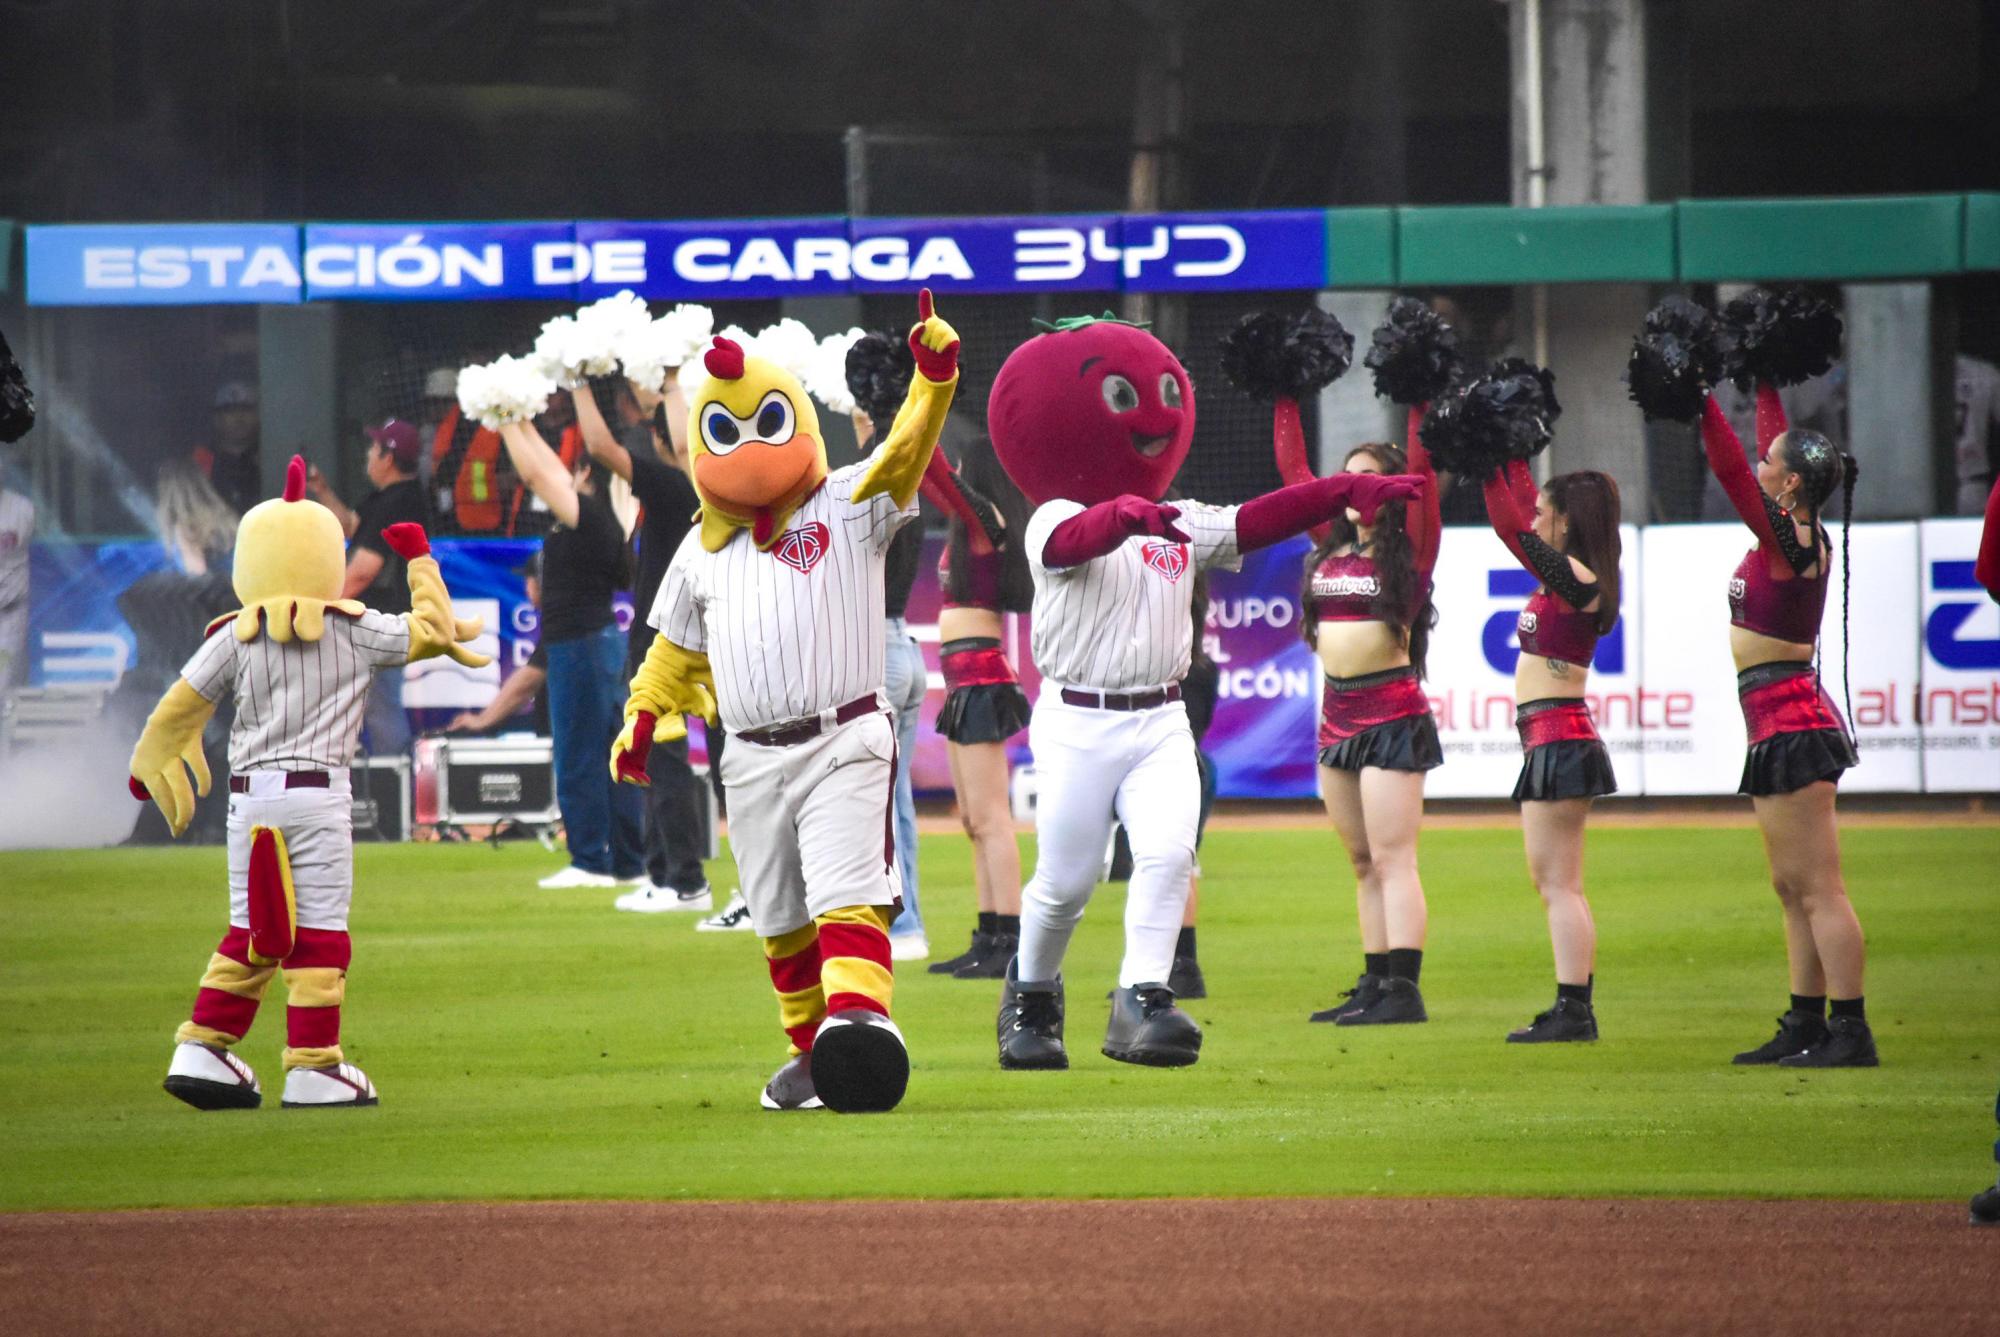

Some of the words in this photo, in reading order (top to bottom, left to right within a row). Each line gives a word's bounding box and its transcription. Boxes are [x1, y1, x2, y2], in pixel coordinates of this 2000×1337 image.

[83, 234, 504, 289] ESTACIÓN
[532, 240, 647, 284] DE
[673, 236, 975, 283] CARGA
[1013, 226, 1247, 282] BYD
[1857, 682, 1898, 725] al
